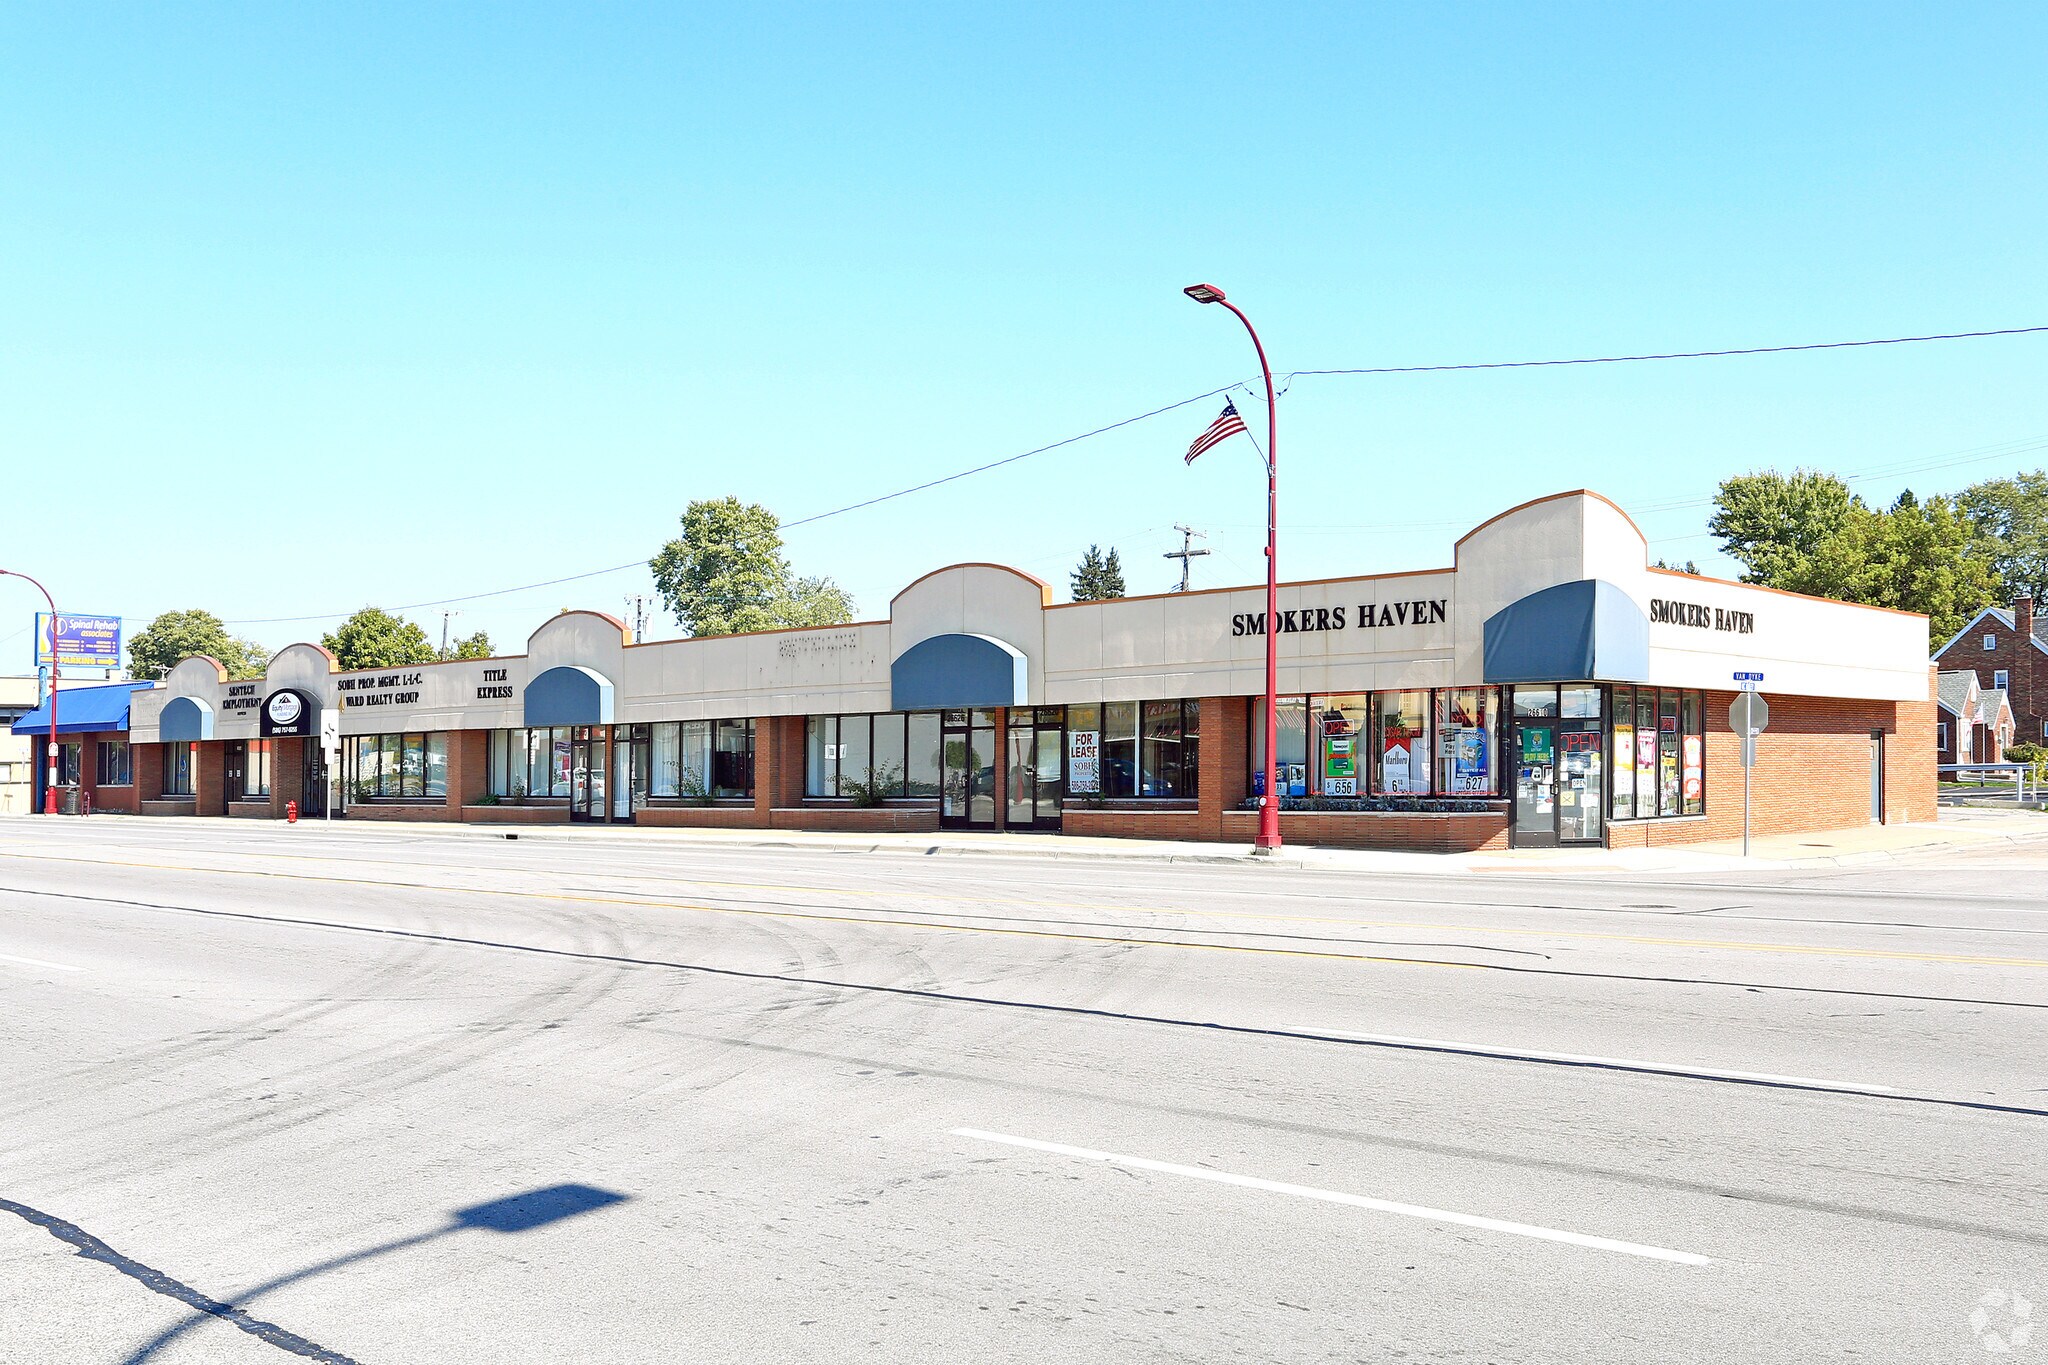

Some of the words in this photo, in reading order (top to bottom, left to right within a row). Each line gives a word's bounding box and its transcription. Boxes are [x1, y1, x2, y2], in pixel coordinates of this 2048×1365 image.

[1357, 600, 1447, 628] HAVEN
[1650, 598, 1710, 629] SMOKERS
[1715, 608, 1753, 634] HAVEN
[69, 619, 93, 630] Spinal
[94, 620, 118, 630] Rehab
[483, 669, 507, 681] TITLE
[337, 679, 356, 691] SOBH
[477, 686, 513, 698] EXPRESS
[346, 696, 365, 707] WARD
[366, 694, 393, 706] REALTY
[395, 692, 419, 704] GROUP
[1325, 721, 1352, 734] OPE
[1076, 733, 1093, 745] FOR
[1560, 734, 1600, 752] OPEN
[1071, 746, 1097, 758] LEASE
[1385, 751, 1407, 765] Marlboro
